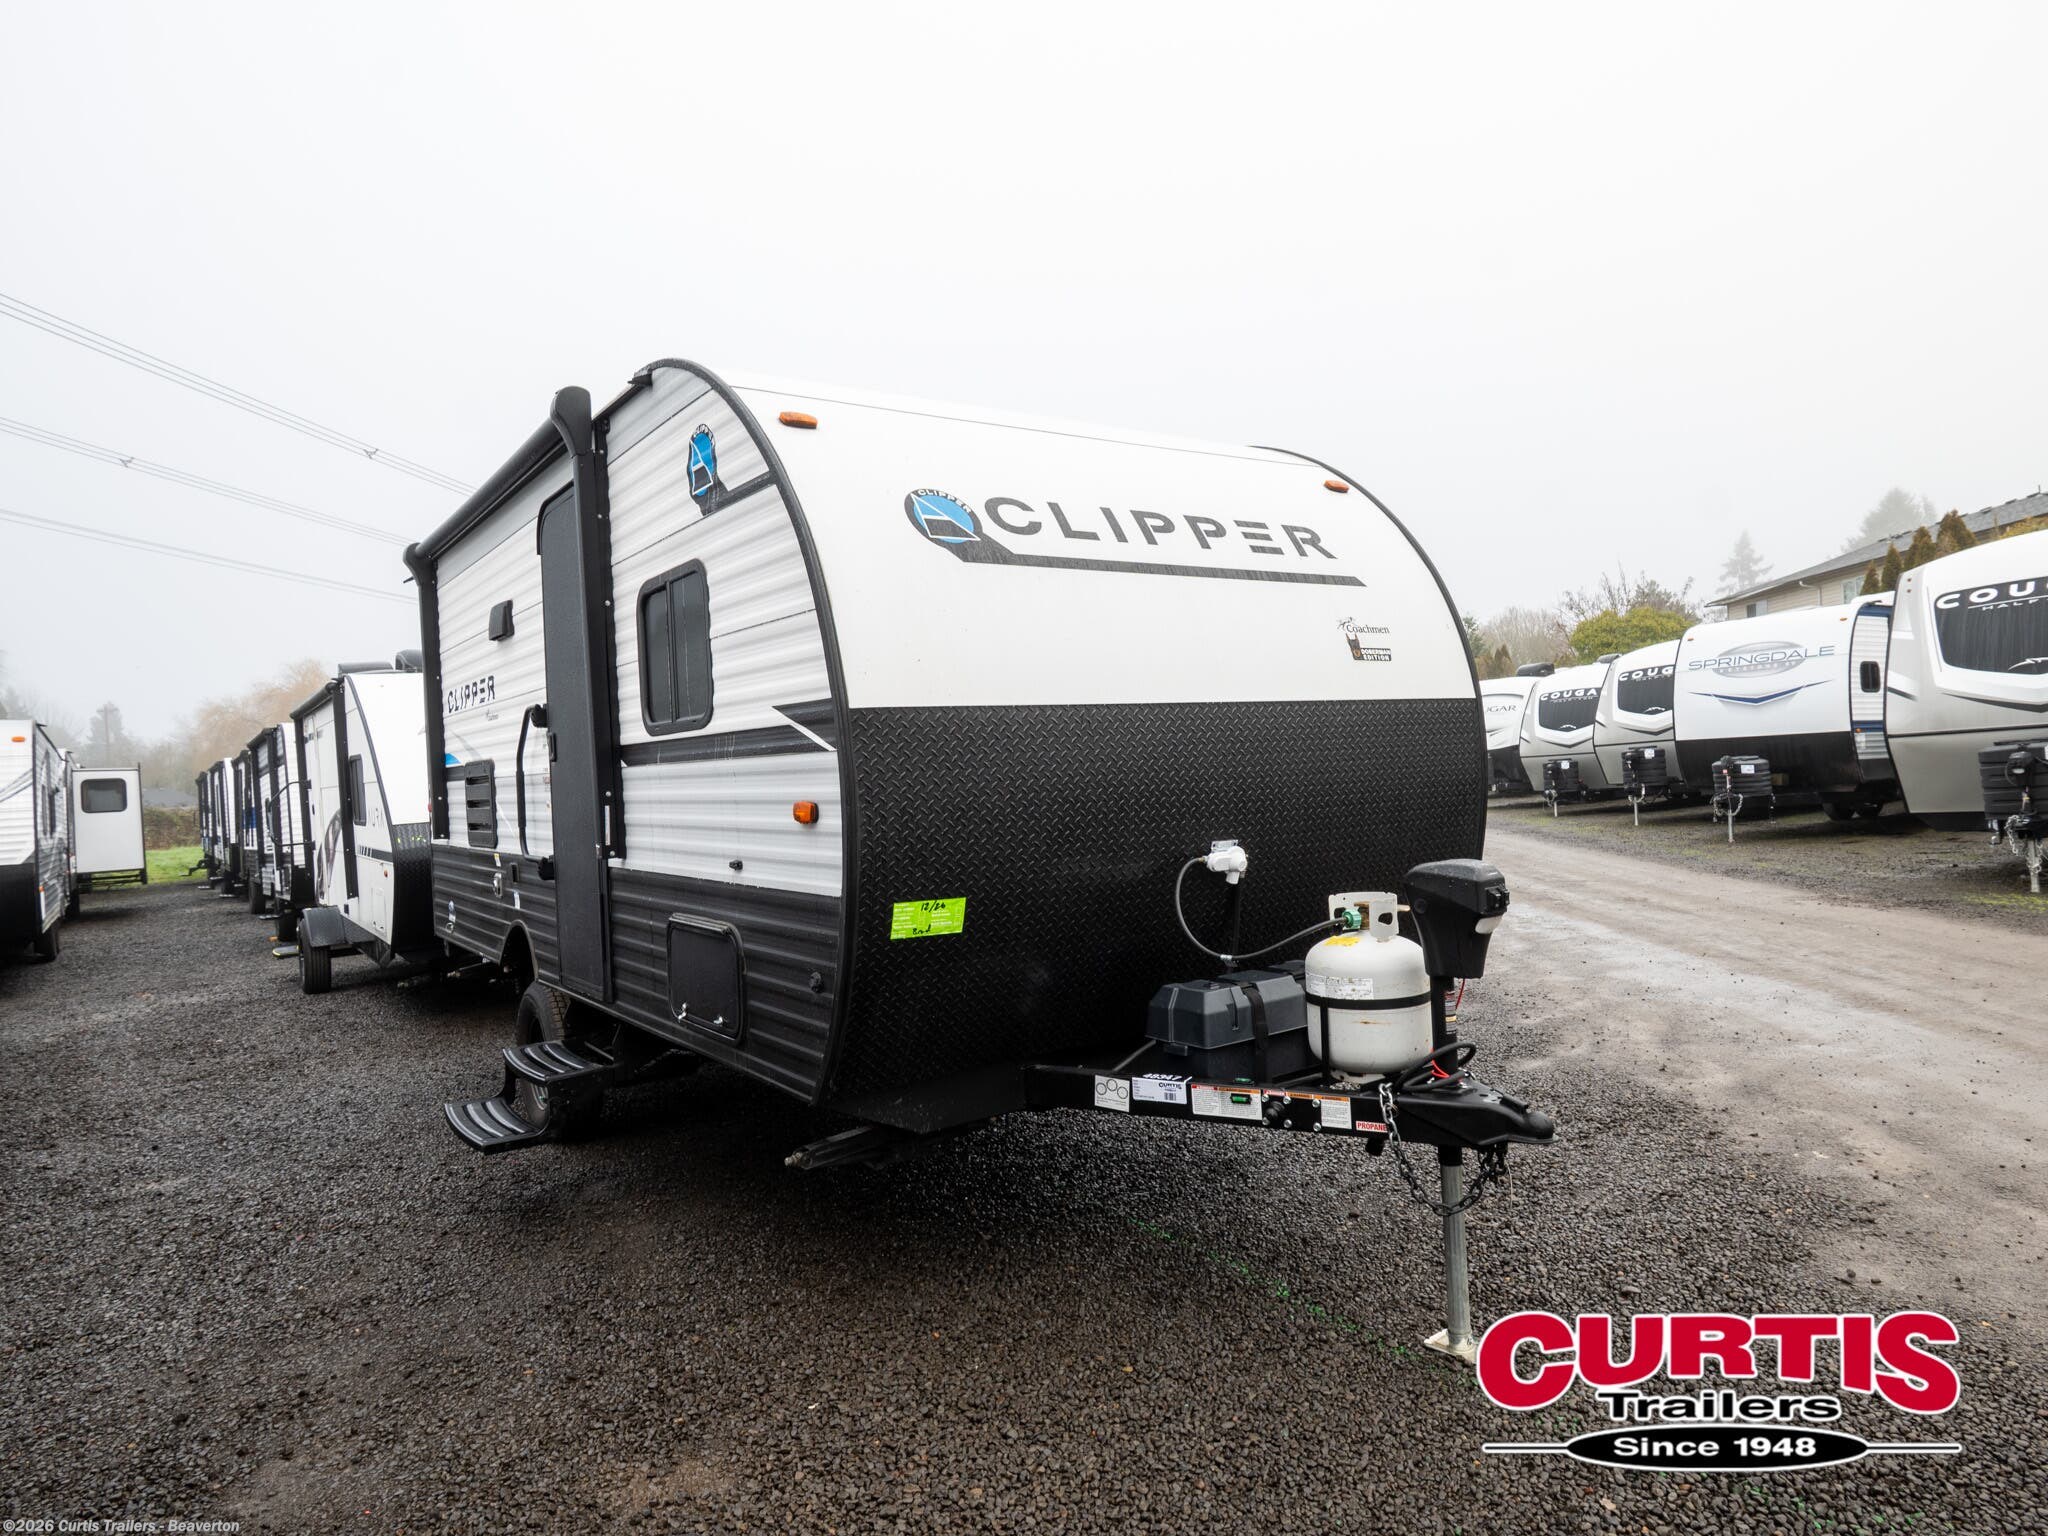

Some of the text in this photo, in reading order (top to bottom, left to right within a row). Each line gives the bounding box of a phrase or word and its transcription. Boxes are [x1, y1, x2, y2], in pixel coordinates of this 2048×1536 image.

[917, 488, 973, 515] CLIPPER
[984, 496, 1338, 560] CLIPPER
[1936, 581, 2048, 609] COU
[1982, 598, 2048, 612] HALF
[1347, 624, 1390, 634] Coachmen
[1688, 645, 1835, 671] SPRINGDALE
[1620, 666, 1674, 681] COUG
[448, 675, 495, 713] CLIPPER
[1541, 688, 1597, 701] COUGA
[1486, 704, 1516, 713] GAR
[1357, 1122, 1387, 1131] PROPANE
